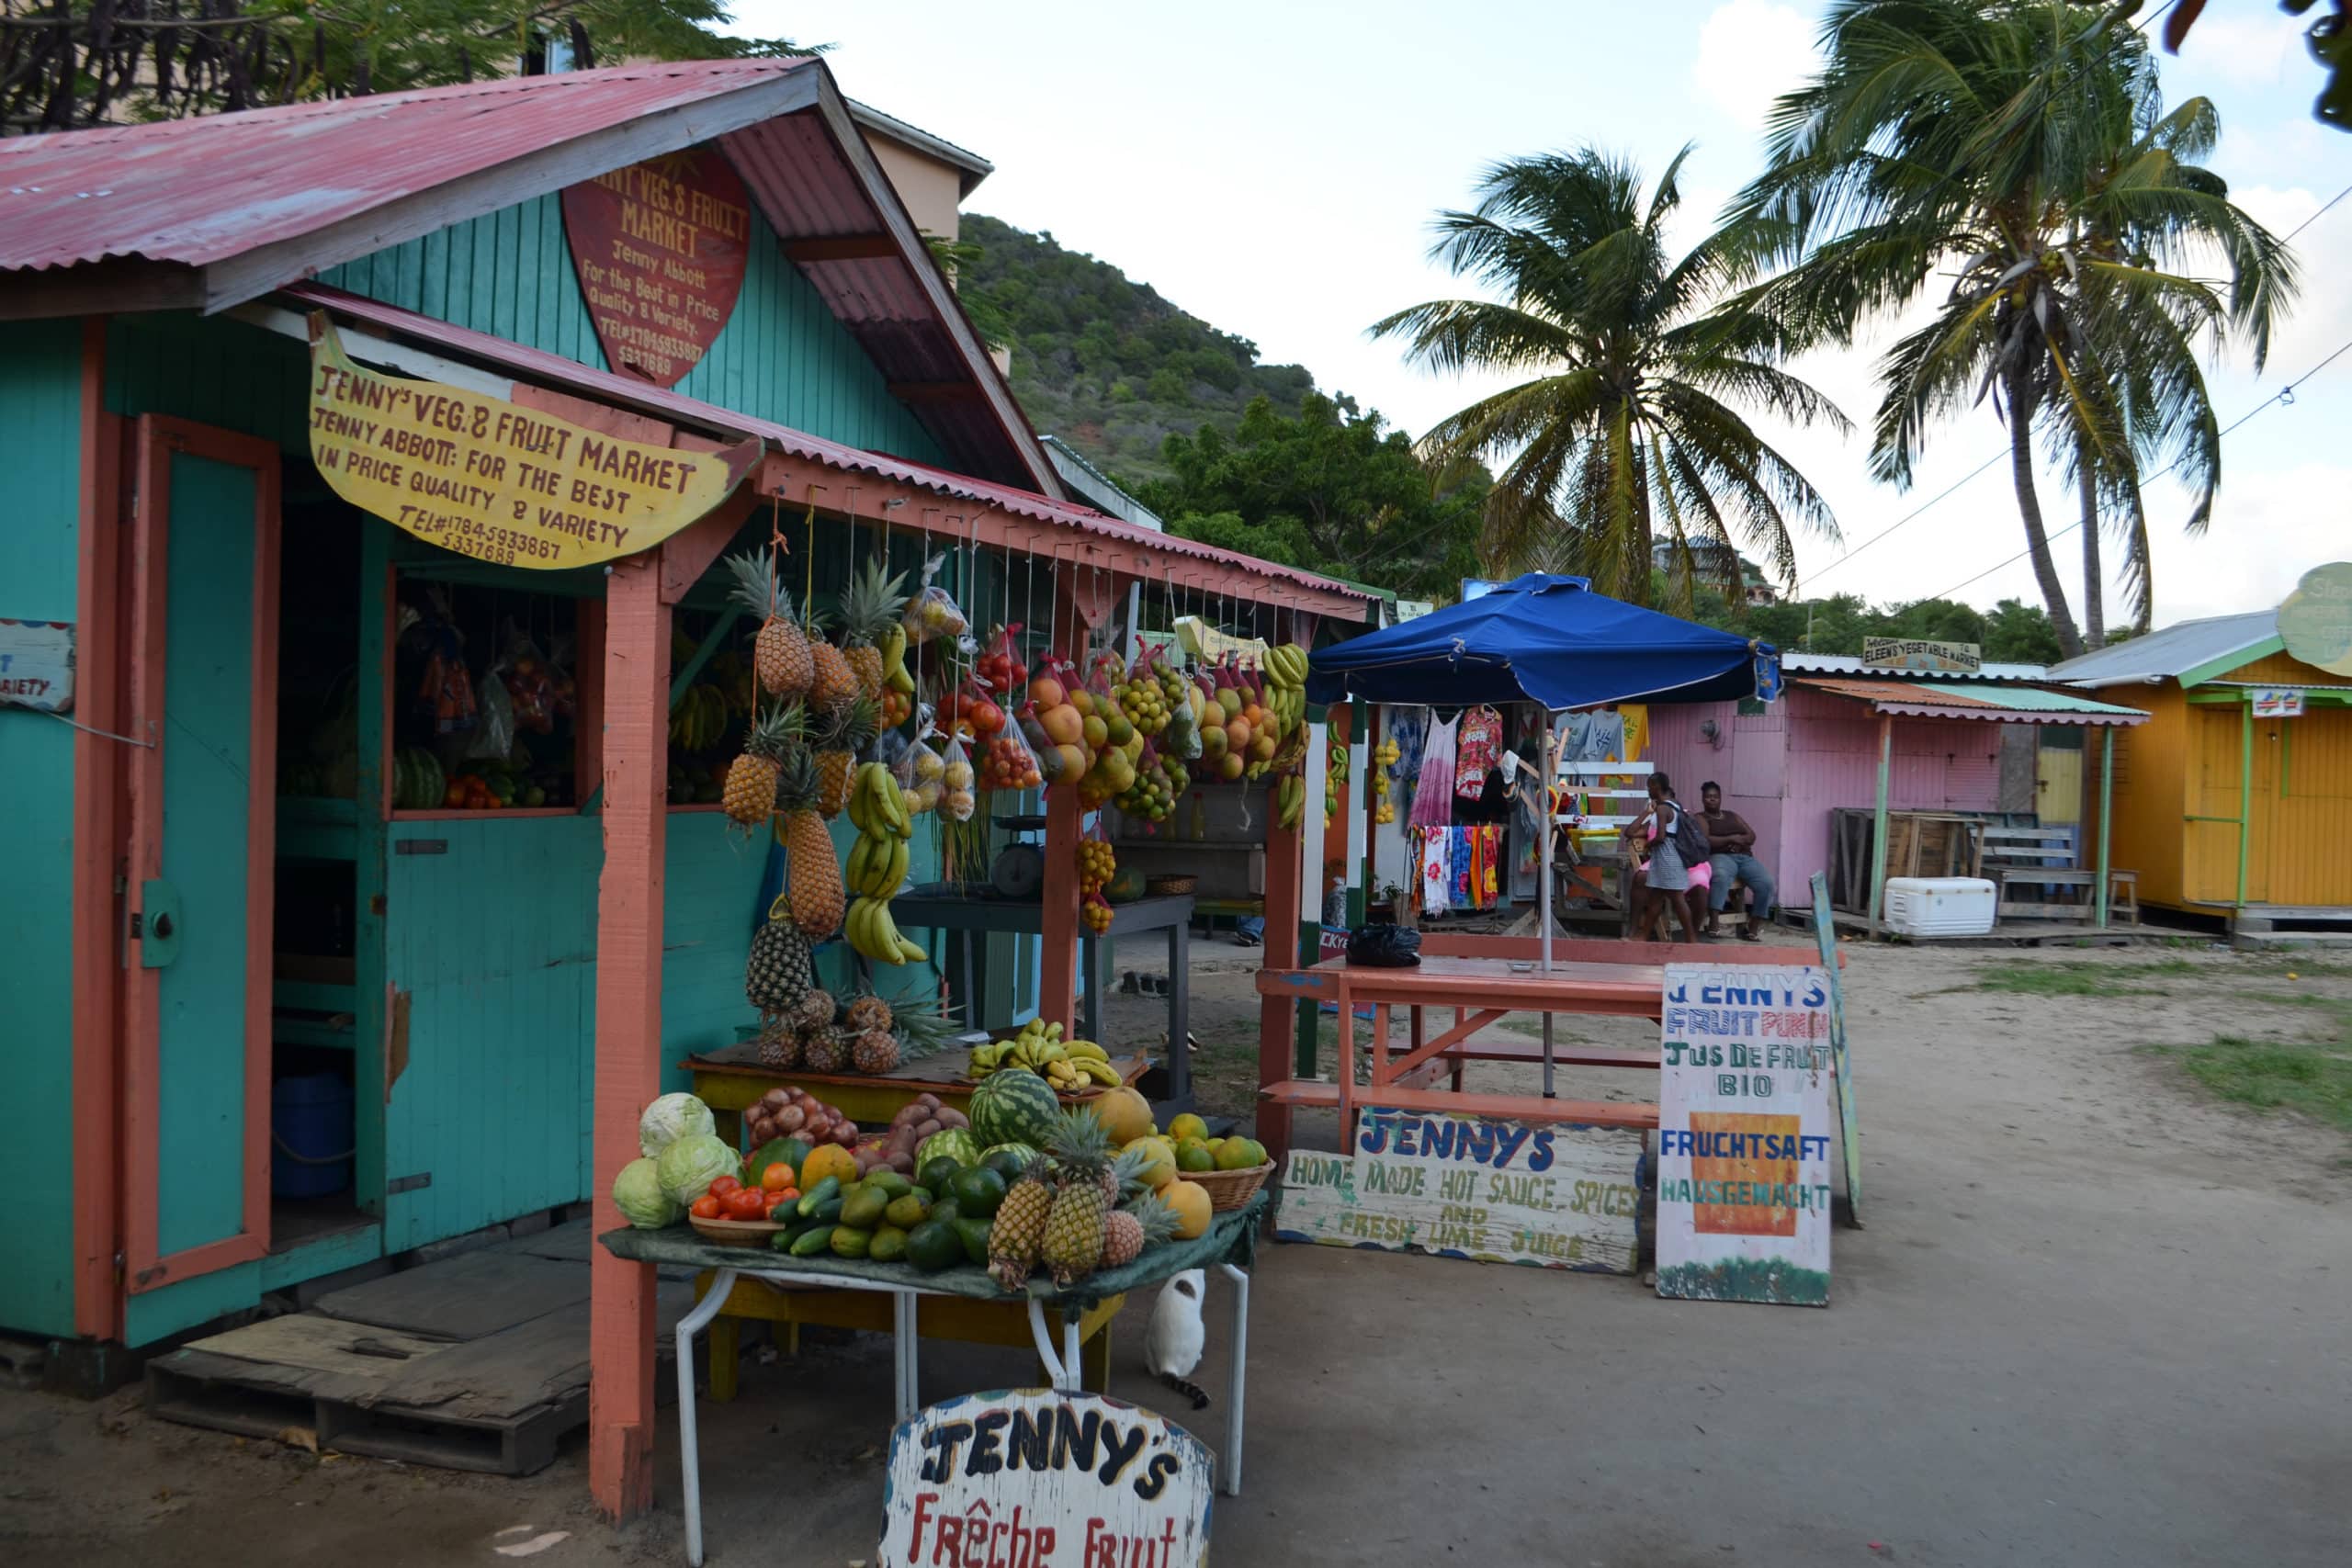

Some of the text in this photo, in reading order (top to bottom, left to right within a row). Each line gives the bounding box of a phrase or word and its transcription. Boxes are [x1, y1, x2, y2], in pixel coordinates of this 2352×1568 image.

[621, 199, 698, 258] MARKET
[691, 189, 748, 242] FRUIT
[613, 239, 707, 291] Jenny Abbott
[582, 258, 720, 322] For the Best in Price
[589, 286, 635, 317] Quality
[313, 406, 379, 445] JENNY
[465, 449, 506, 482] FOR
[517, 461, 563, 497] THE
[570, 479, 632, 514] BEST
[495, 412, 572, 461] FRUIT
[578, 435, 698, 495] MARKET
[317, 444, 340, 469] IN
[345, 451, 404, 488] PRICE
[410, 470, 496, 512] QUALITY
[537, 506, 630, 549] VARIETY
[441, 532, 515, 566] 5337689
[1898, 641, 1948, 659] VEGETABLE
[1666, 966, 1826, 1008] JENNY'S
[1666, 1008, 1829, 1039] FRUIT PUNCH
[1718, 1074, 1773, 1098] BIO
[1660, 1129, 1830, 1162] FRUCHTSAFT
[1291, 1155, 1354, 1191] HOME
[1364, 1159, 1426, 1197] MADE
[1440, 1168, 1479, 1202] HOT
[1487, 1172, 1557, 1211] SAUCE
[1570, 1179, 1640, 1217] SPICES
[1661, 1177, 1831, 1211] HAUSGEMACHT
[1339, 1212, 1585, 1259] FRESH LIME JUICE
[1441, 1204, 1488, 1225] AND
[919, 1403, 1182, 1502] JENNY'S
